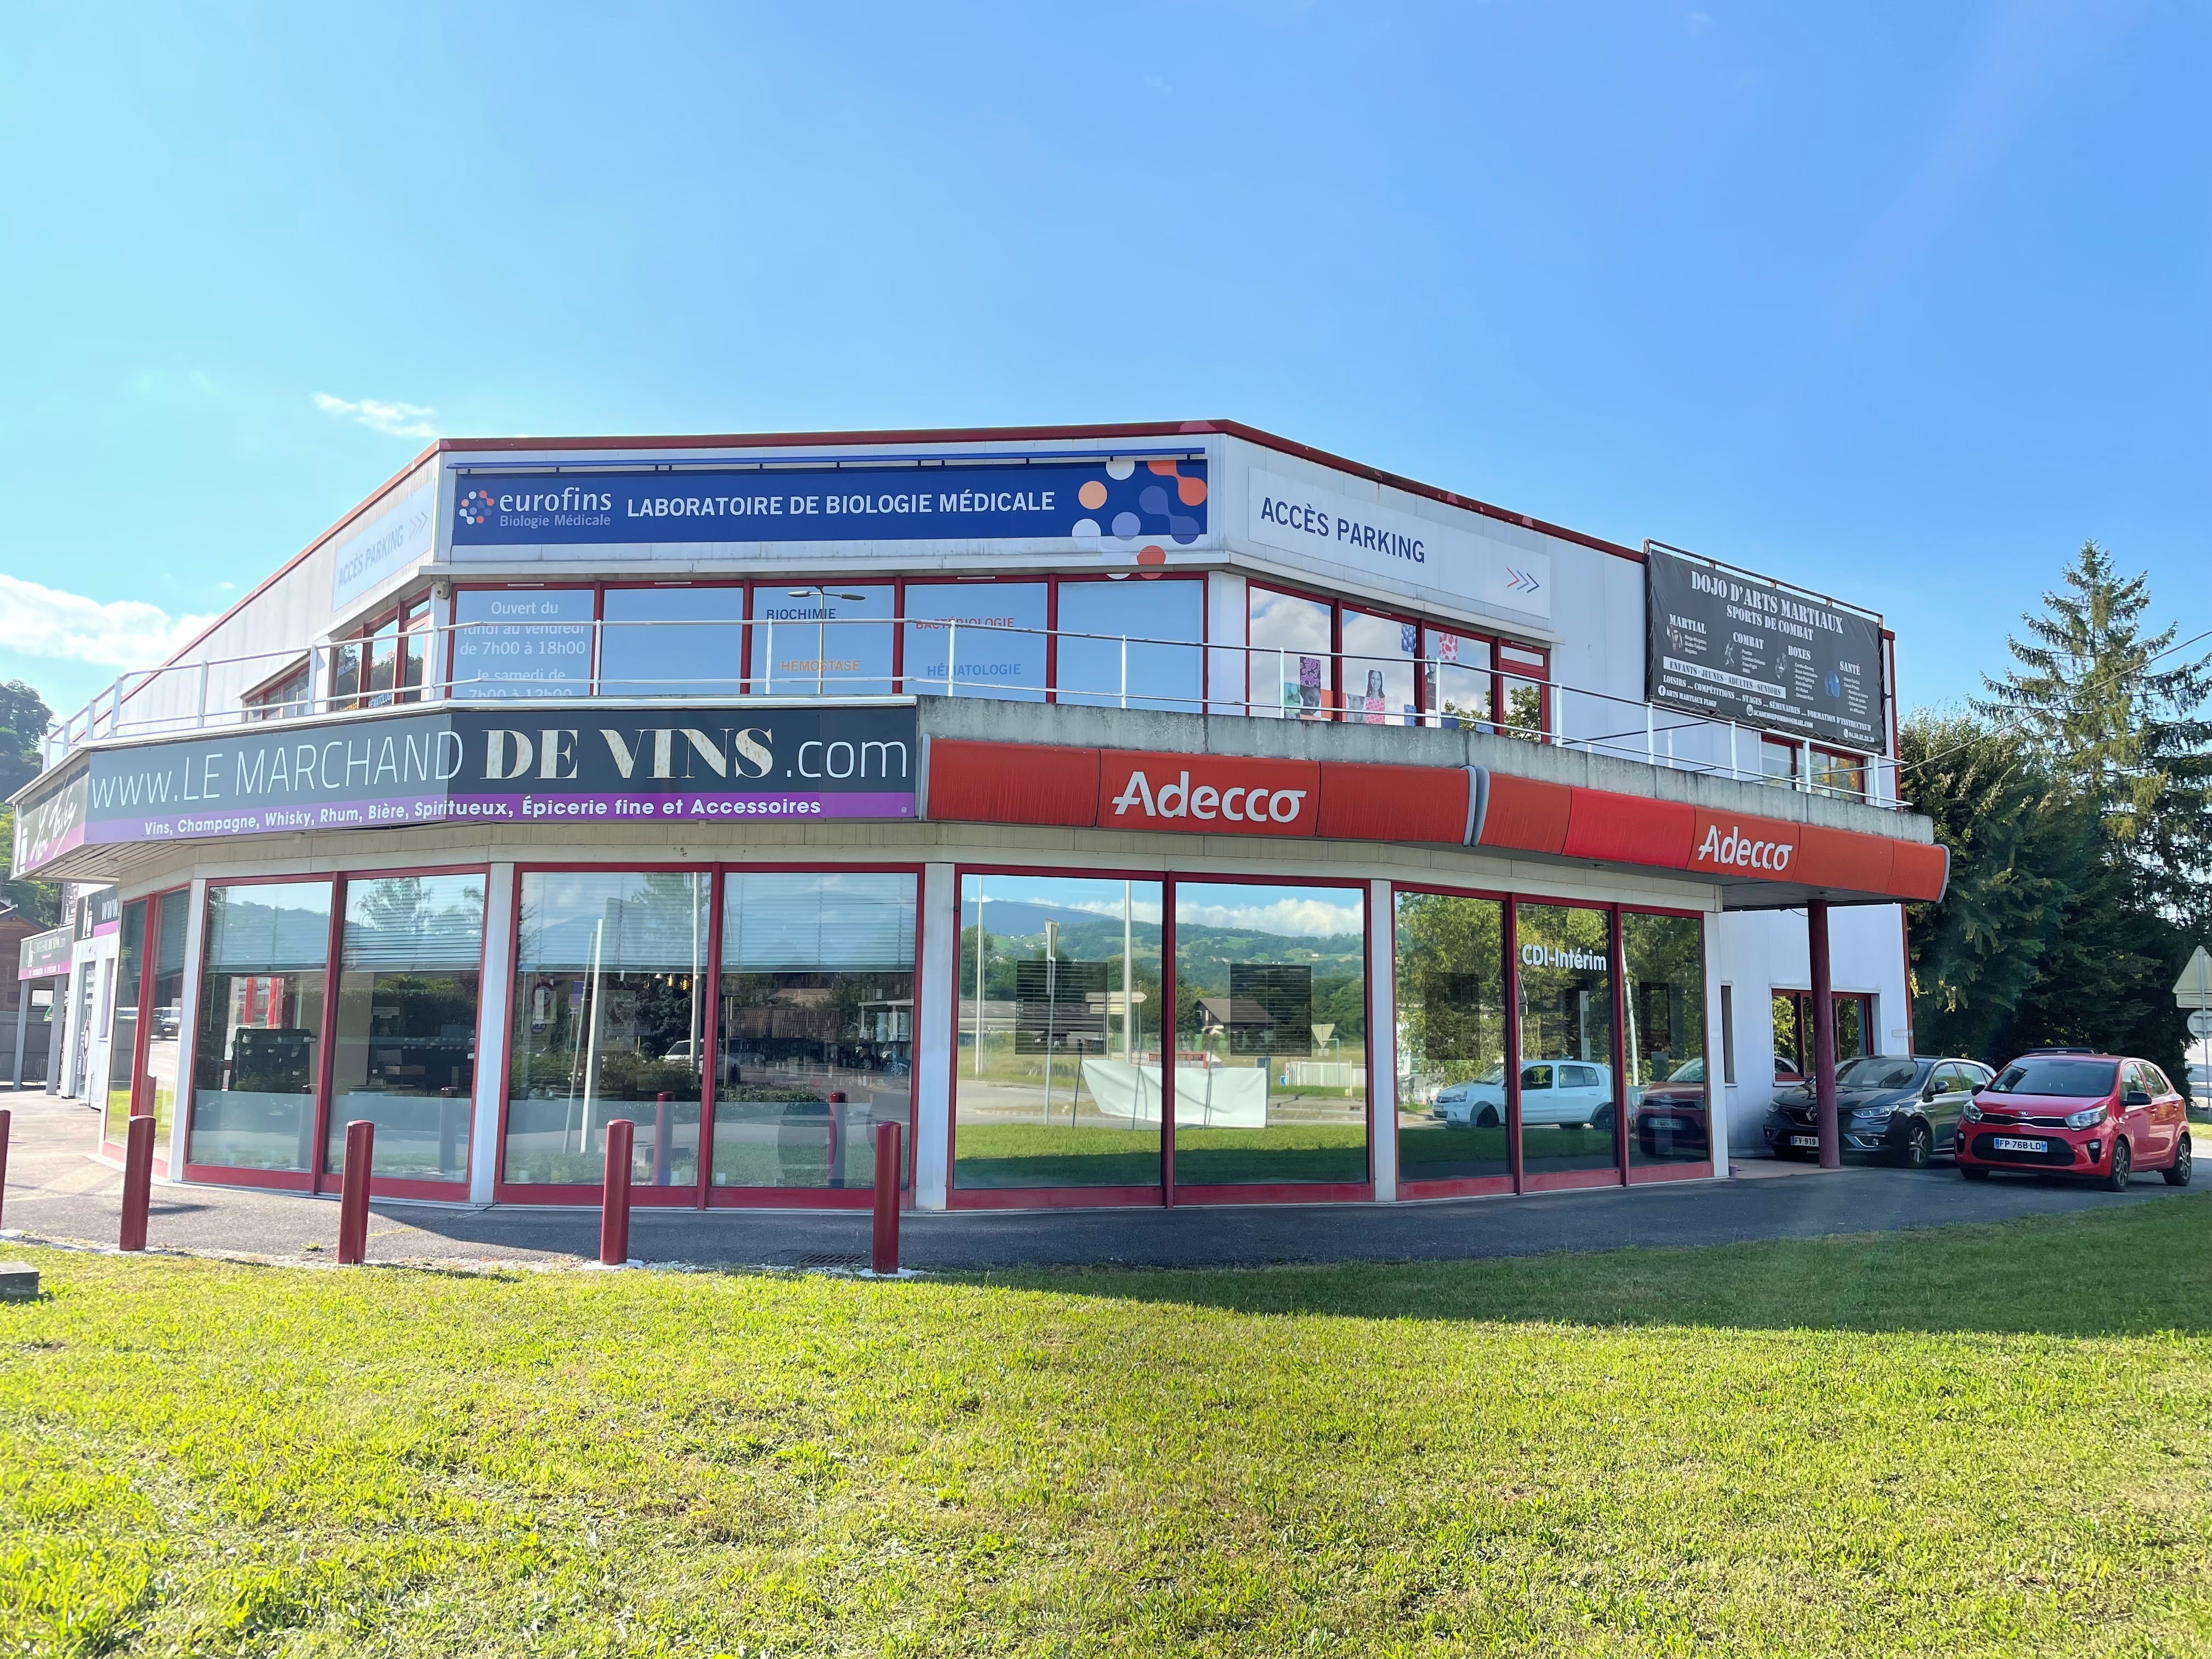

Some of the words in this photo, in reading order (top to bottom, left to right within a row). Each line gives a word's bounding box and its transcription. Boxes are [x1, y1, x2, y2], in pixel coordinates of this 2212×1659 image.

[499, 487, 612, 512] eurofins
[627, 496, 783, 517] LABORATOIRE
[790, 496, 819, 515] DE
[826, 494, 932, 514] BIOLOGIE
[939, 489, 1056, 511] MÉDICALE
[500, 514, 549, 528] Biologie
[554, 514, 611, 527] Médicale
[1261, 496, 1329, 537] ACCÈS
[1338, 518, 1425, 564] PARKING
[338, 554, 363, 589] ACCÈS
[365, 525, 403, 570] PARKING
[491, 601, 536, 614] Ouvert
[541, 601, 558, 614] du
[766, 608, 836, 619] BIOCHIMIE
[1691, 571, 1728, 599] DOJO
[1781, 599, 1844, 634] MARTIAUX
[504, 624, 520, 635] au
[1669, 613, 1707, 634] MARTIAL
[1726, 604, 1762, 627] SPORTS
[1764, 616, 1776, 630] DE
[1778, 619, 1813, 641] COMBAT
[460, 642, 477, 655] de
[482, 642, 520, 655] 7h00
[524, 641, 532, 654] à
[539, 641, 586, 654] 18h00
[1733, 631, 1764, 650] COMBAT
[1788, 645, 1811, 661] BOXES
[478, 669, 489, 679] le
[494, 669, 543, 679] samedi
[549, 669, 566, 679] de
[781, 659, 860, 672] HÉMOSTASE
[1839, 661, 1860, 676] SANTÉ
[1670, 661, 1697, 675] ENFANTS
[1701, 669, 1724, 682] JEUNES
[1728, 676, 1753, 689] ADULTES
[1757, 683, 1781, 696] SENIORS
[1663, 675, 1686, 687] LOISIRS
[1694, 682, 1735, 699] COMPÉTITIONS
[1742, 695, 1762, 706] STAGES
[1769, 700, 1800, 714] SÉMINAIRES
[1808, 709, 1836, 723] FORMATION
[1679, 692, 1702, 704] MARTIAUX
[236, 730, 463, 794] MARCHAND
[481, 729, 579, 780] DE
[1112, 771, 1306, 823] Adecco
[145, 820, 172, 837] Vins,
[177, 815, 261, 834] Champagne,
[265, 810, 314, 828] Whisky,
[320, 805, 363, 824] Rhum,
[368, 802, 409, 820] Bière,
[414, 799, 513, 819] Spiritueux,
[522, 796, 608, 820] Épicerie
[616, 798, 655, 815] fine
[663, 799, 684, 814] et
[690, 798, 821, 814] Accessoires
[1697, 824, 1793, 872] Adecco
[1522, 944, 1606, 972] CDI-Intérim
[2000, 1140, 2040, 1150] FP-768-LD
